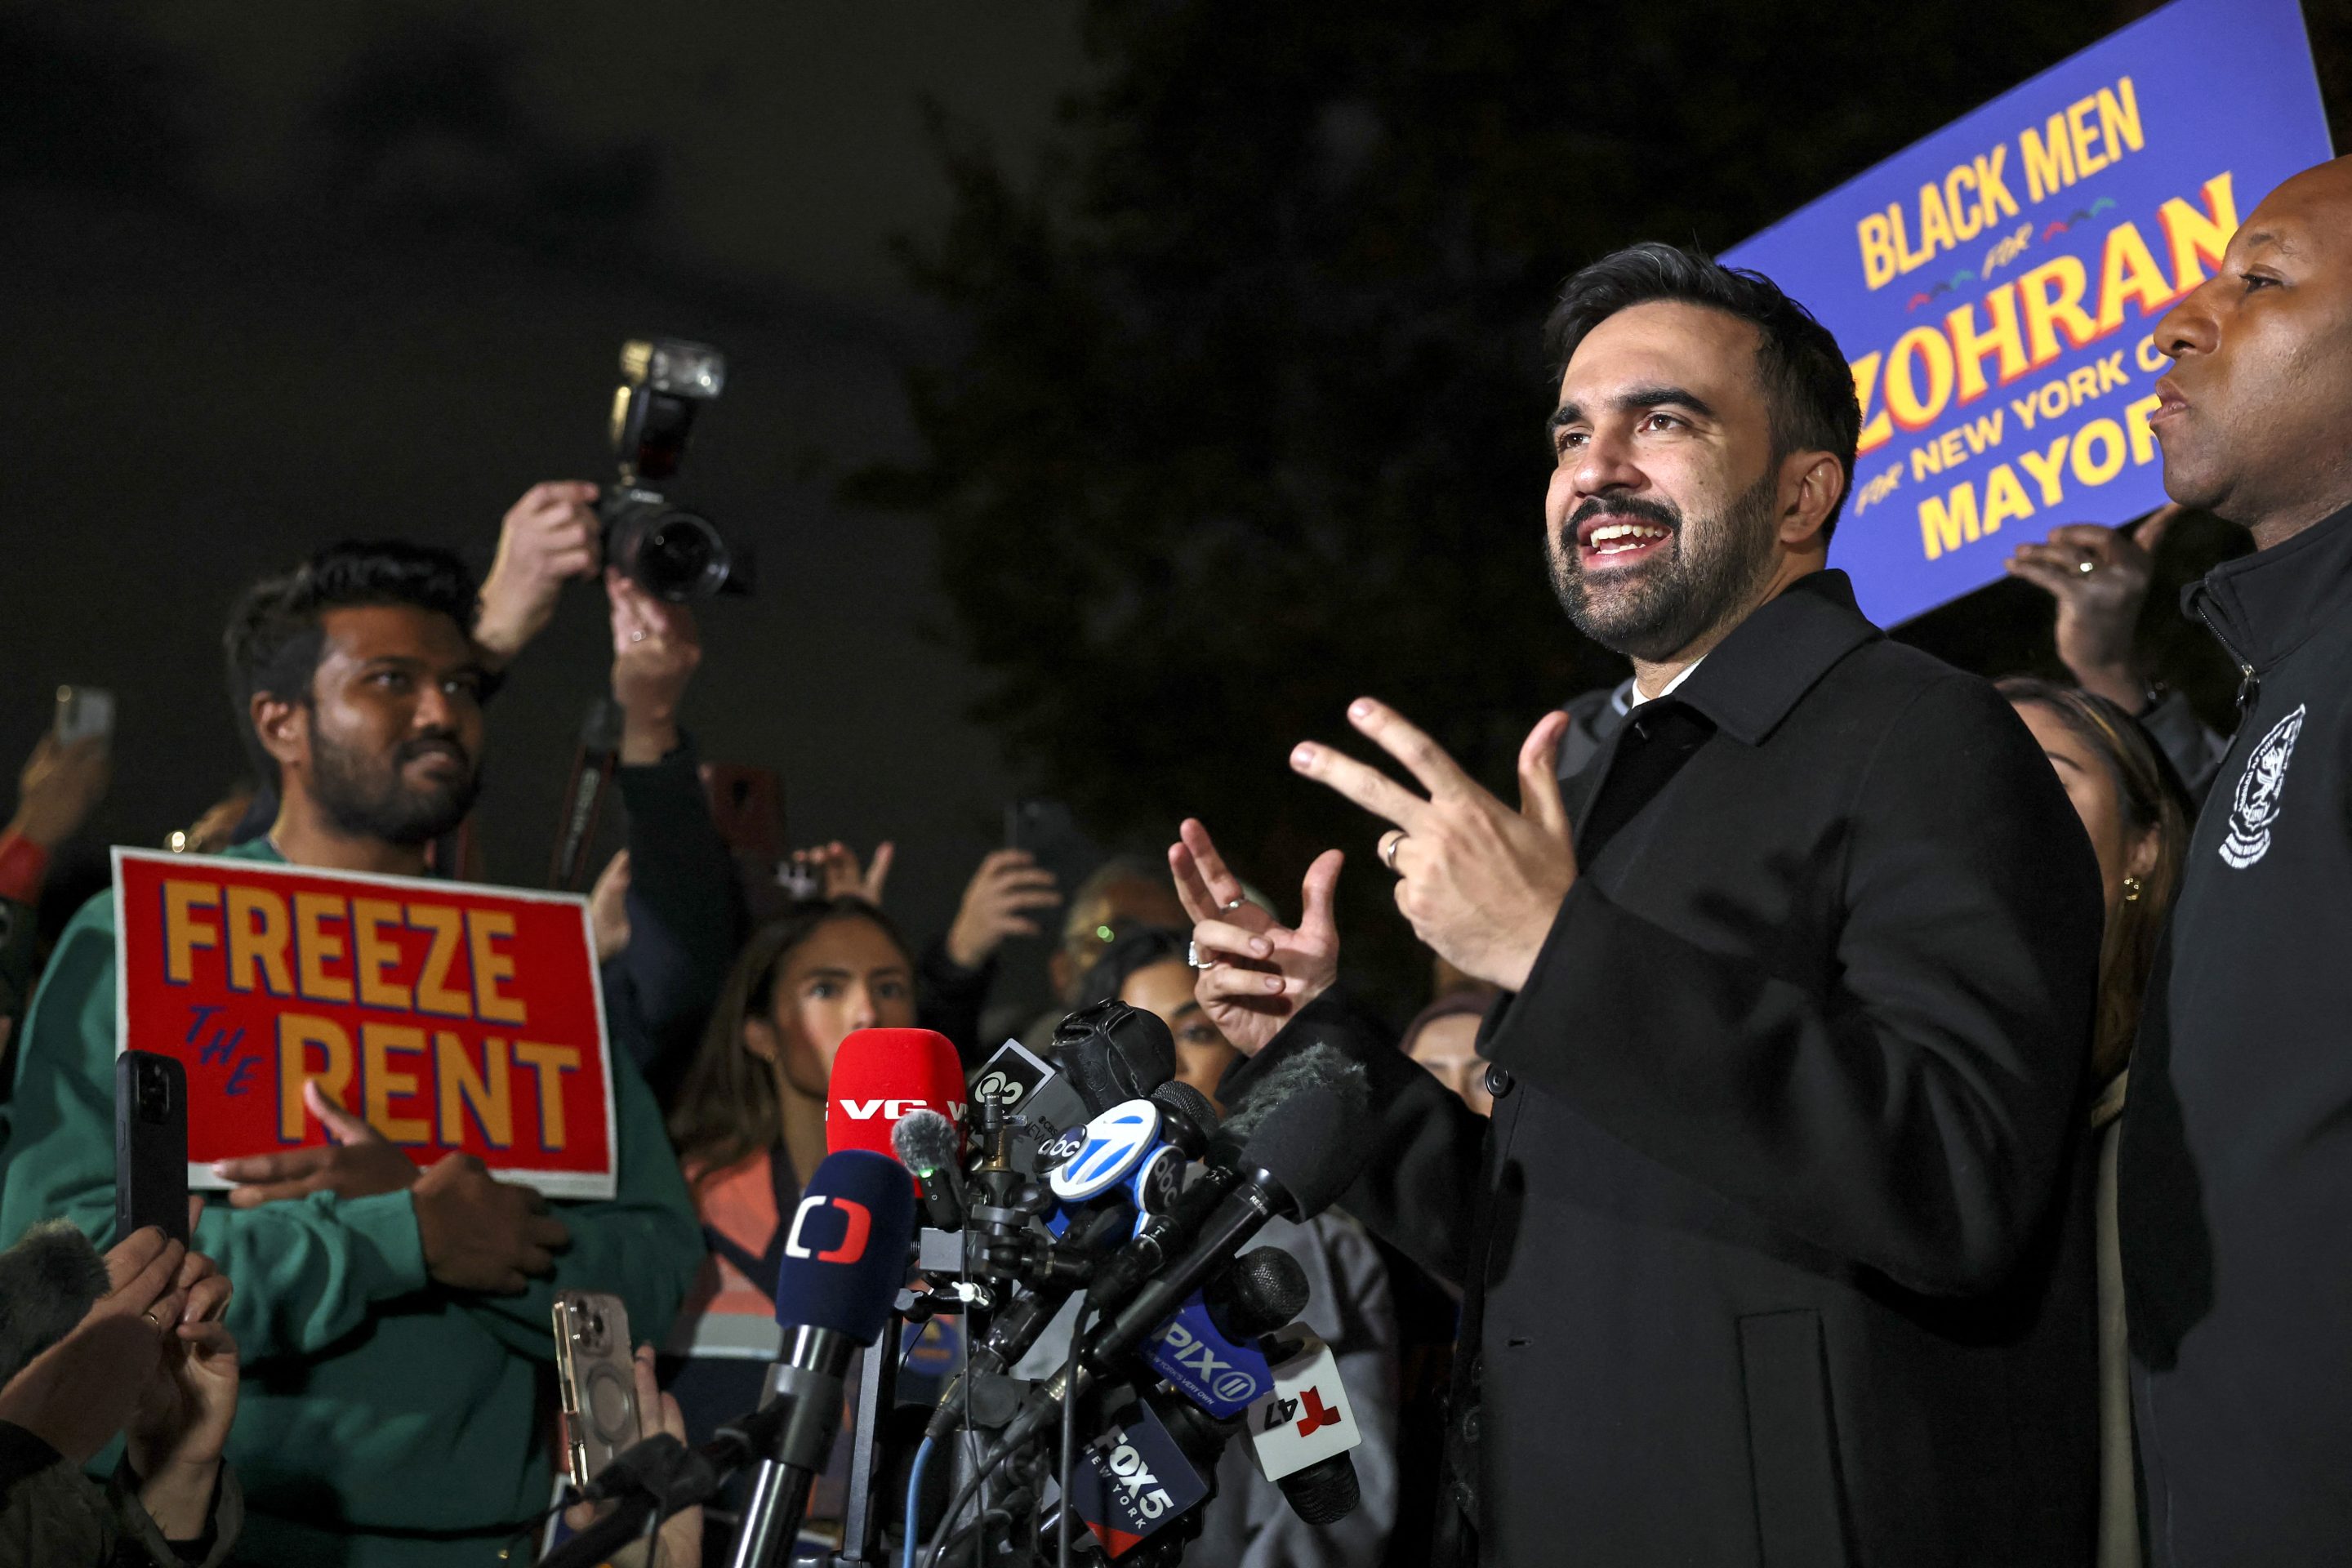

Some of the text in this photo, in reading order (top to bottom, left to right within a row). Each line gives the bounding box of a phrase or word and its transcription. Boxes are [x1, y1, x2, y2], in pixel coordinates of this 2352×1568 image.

[1856, 76, 2145, 291] BLACK MEN
[1980, 222, 2034, 282] FOR
[1847, 170, 2240, 457] ZOHRAN
[1910, 408, 2004, 483] NEW
[2011, 350, 2130, 429] YORK
[162, 879, 527, 1026] FREEZE
[185, 1004, 263, 1096] THE
[276, 1012, 580, 1152] RENT
[840, 1099, 928, 1120] VG
[947, 1100, 969, 1121] V
[1027, 1121, 1049, 1145] NEW
[1038, 1134, 1080, 1157] abc
[1154, 1156, 1178, 1207] abc
[1151, 1321, 1232, 1383] PIX
[1197, 1391, 1215, 1405] OWN
[1264, 1398, 1298, 1431] 47
[1083, 1444, 1146, 1529] NEW YORK
[1093, 1424, 1174, 1519] FOX 5
